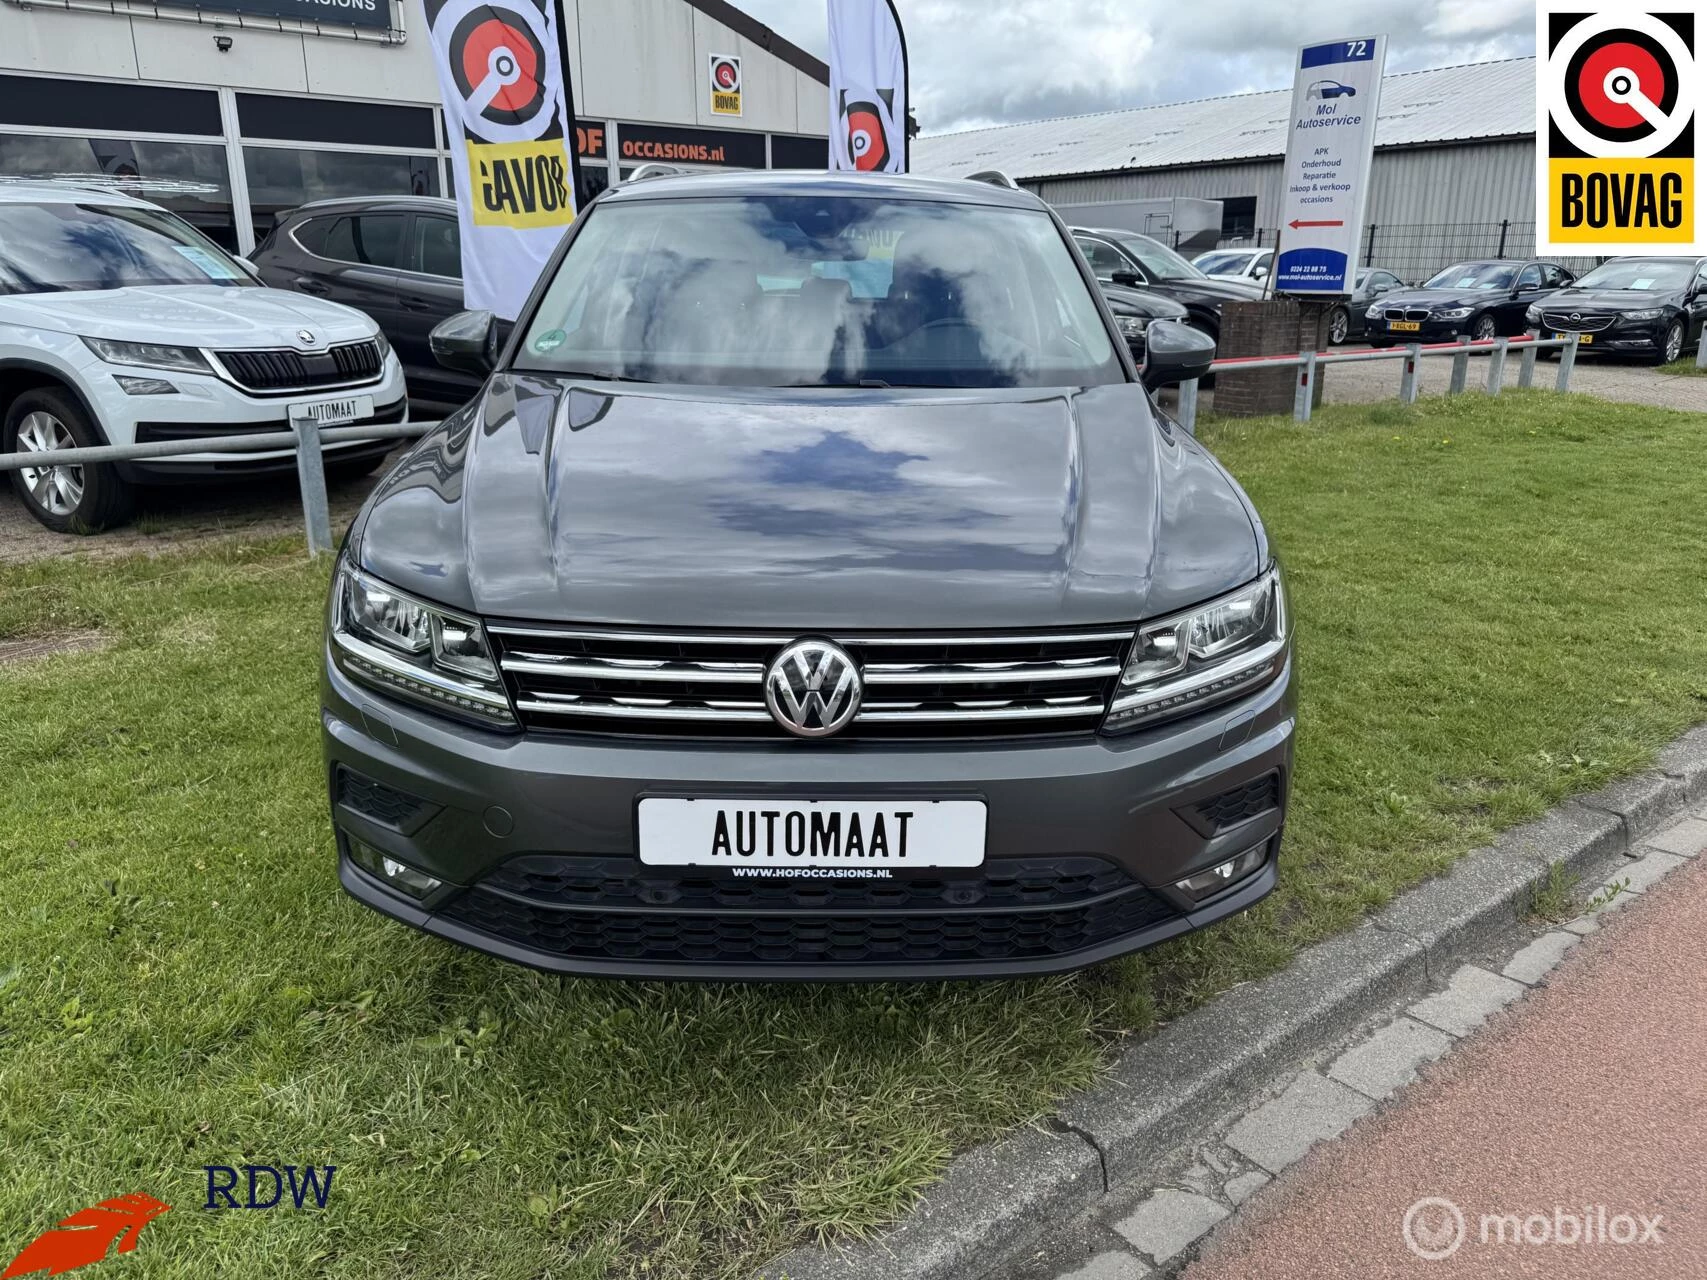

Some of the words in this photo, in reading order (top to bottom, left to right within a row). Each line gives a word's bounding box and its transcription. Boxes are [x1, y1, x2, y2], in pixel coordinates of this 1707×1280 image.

[1347, 41, 1367, 57] 72
[715, 95, 739, 110] BOVAG
[1316, 103, 1337, 116] Mol
[1296, 114, 1362, 130] Autoservice
[622, 140, 725, 162] OCCASIONS.nl
[1314, 147, 1329, 156] APK
[1301, 158, 1342, 169] Onderhoud
[1303, 171, 1337, 182] Reparatie
[1312, 183, 1318, 192] &
[1319, 183, 1351, 192] verkoop
[1300, 195, 1334, 204] occasions
[308, 400, 356, 421] AUTOMAAT
[711, 809, 914, 858] AUTOMAAT
[732, 867, 893, 879] WWW.HOFOCCASIONS.NL
